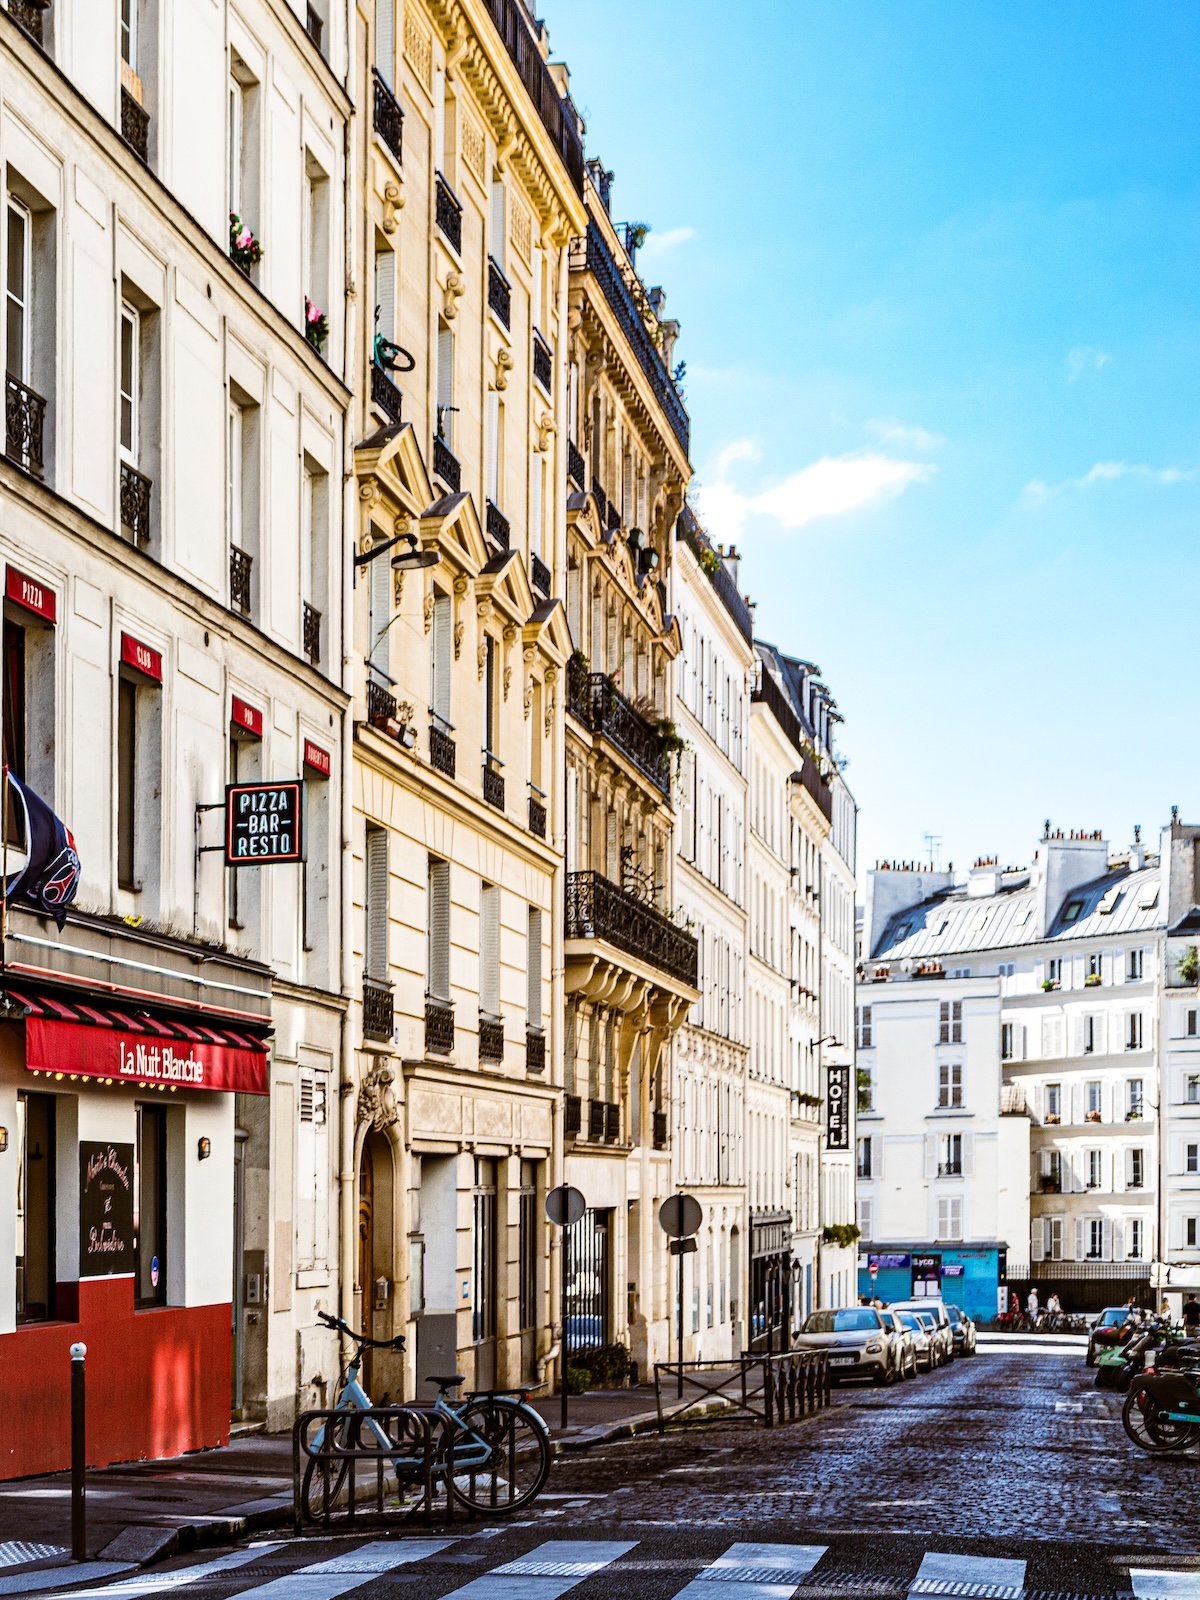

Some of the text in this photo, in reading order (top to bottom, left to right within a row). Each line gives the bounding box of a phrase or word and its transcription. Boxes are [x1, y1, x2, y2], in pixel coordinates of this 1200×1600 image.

[22, 580, 43, 609] PIZZA
[136, 646, 152, 669] CLUB
[240, 791, 288, 813] PIZZA
[238, 833, 290, 857] RESTO
[119, 1041, 204, 1083] La Nuit Blanche
[829, 1069, 843, 1145] HOTEL
